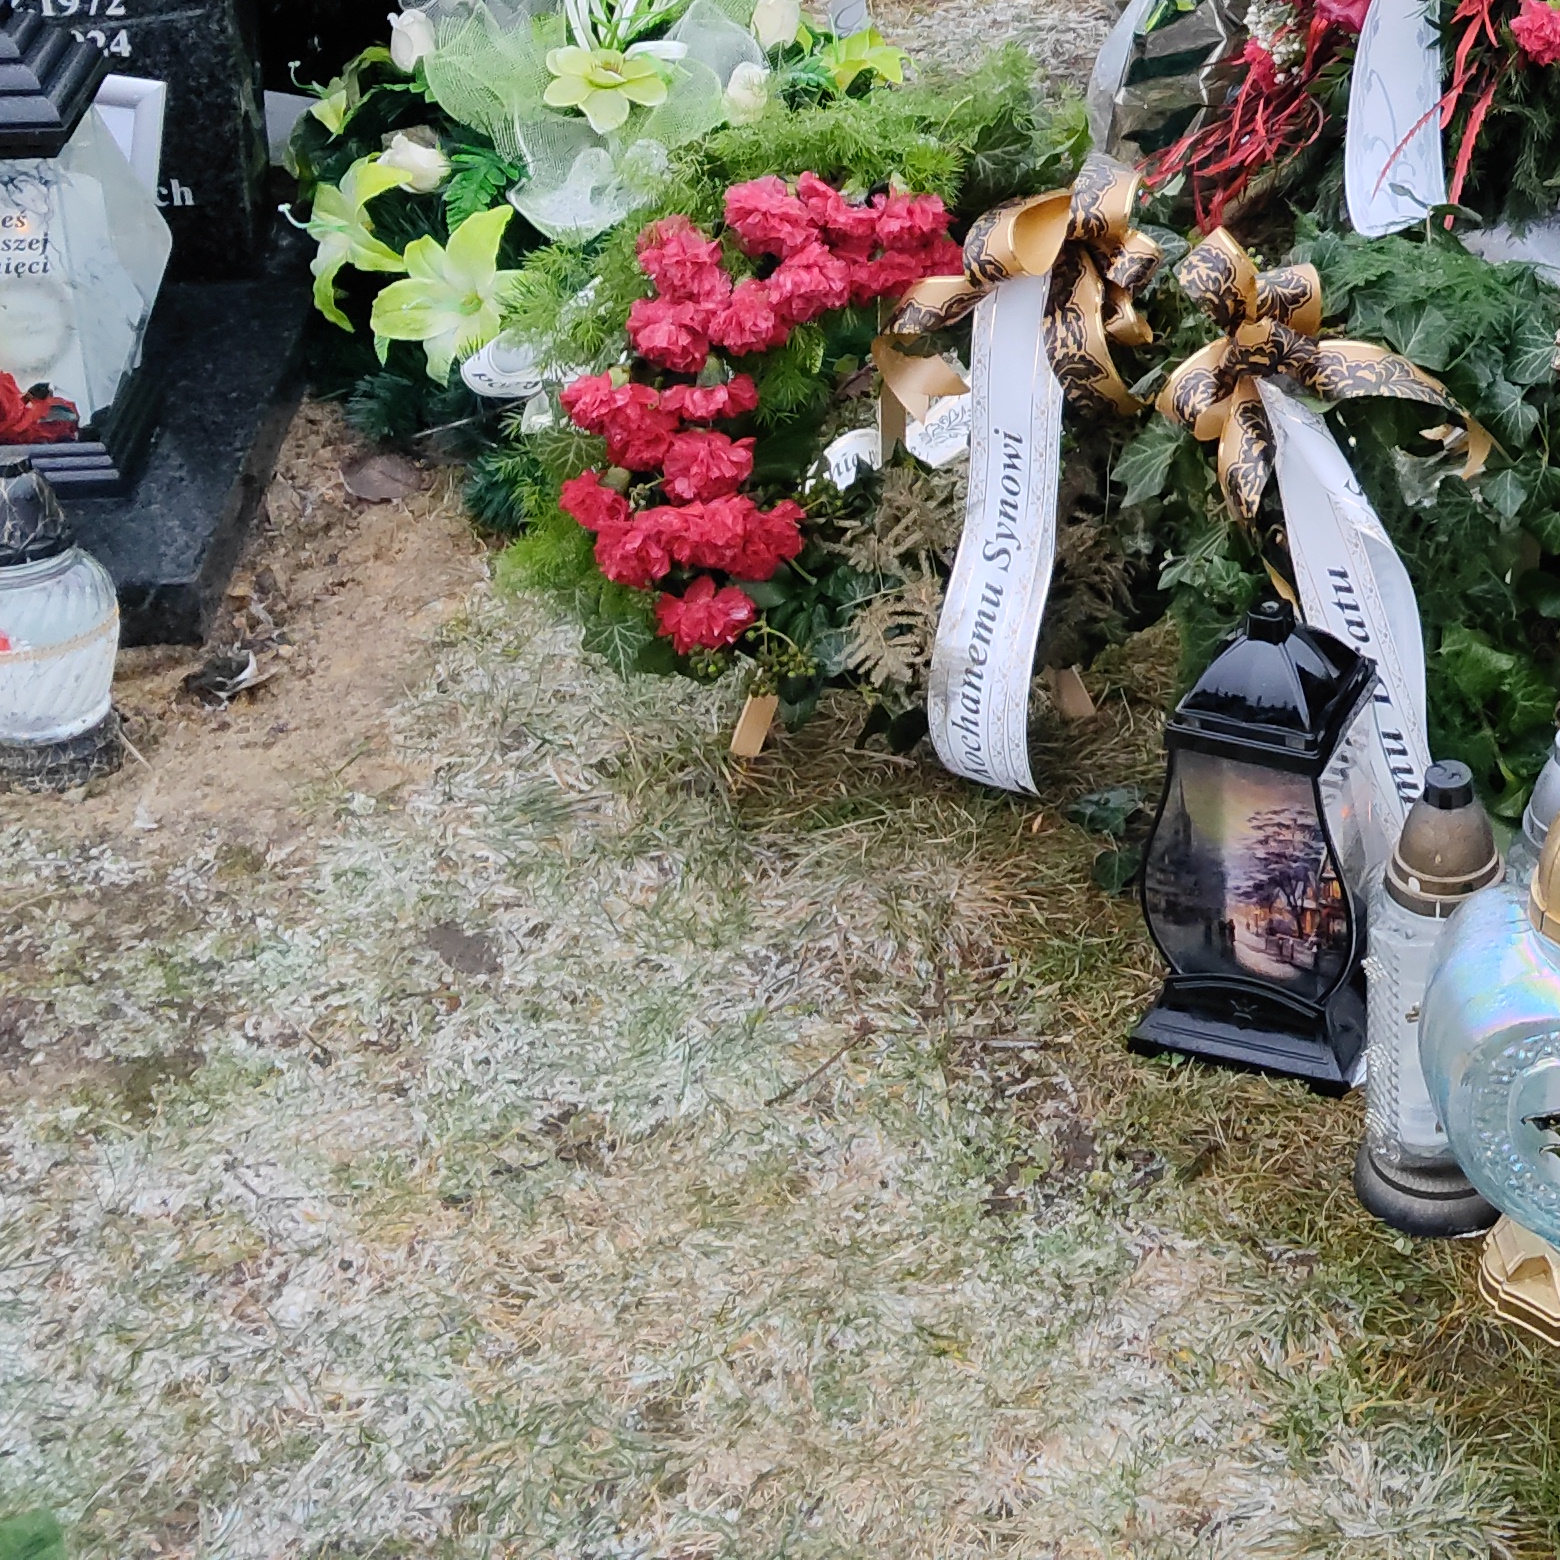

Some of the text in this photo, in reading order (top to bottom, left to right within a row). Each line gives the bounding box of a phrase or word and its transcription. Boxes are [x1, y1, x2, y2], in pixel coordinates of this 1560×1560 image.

[0, 255, 51, 279] ięci
[951, 427, 1026, 781] Kochanemu Synowi
